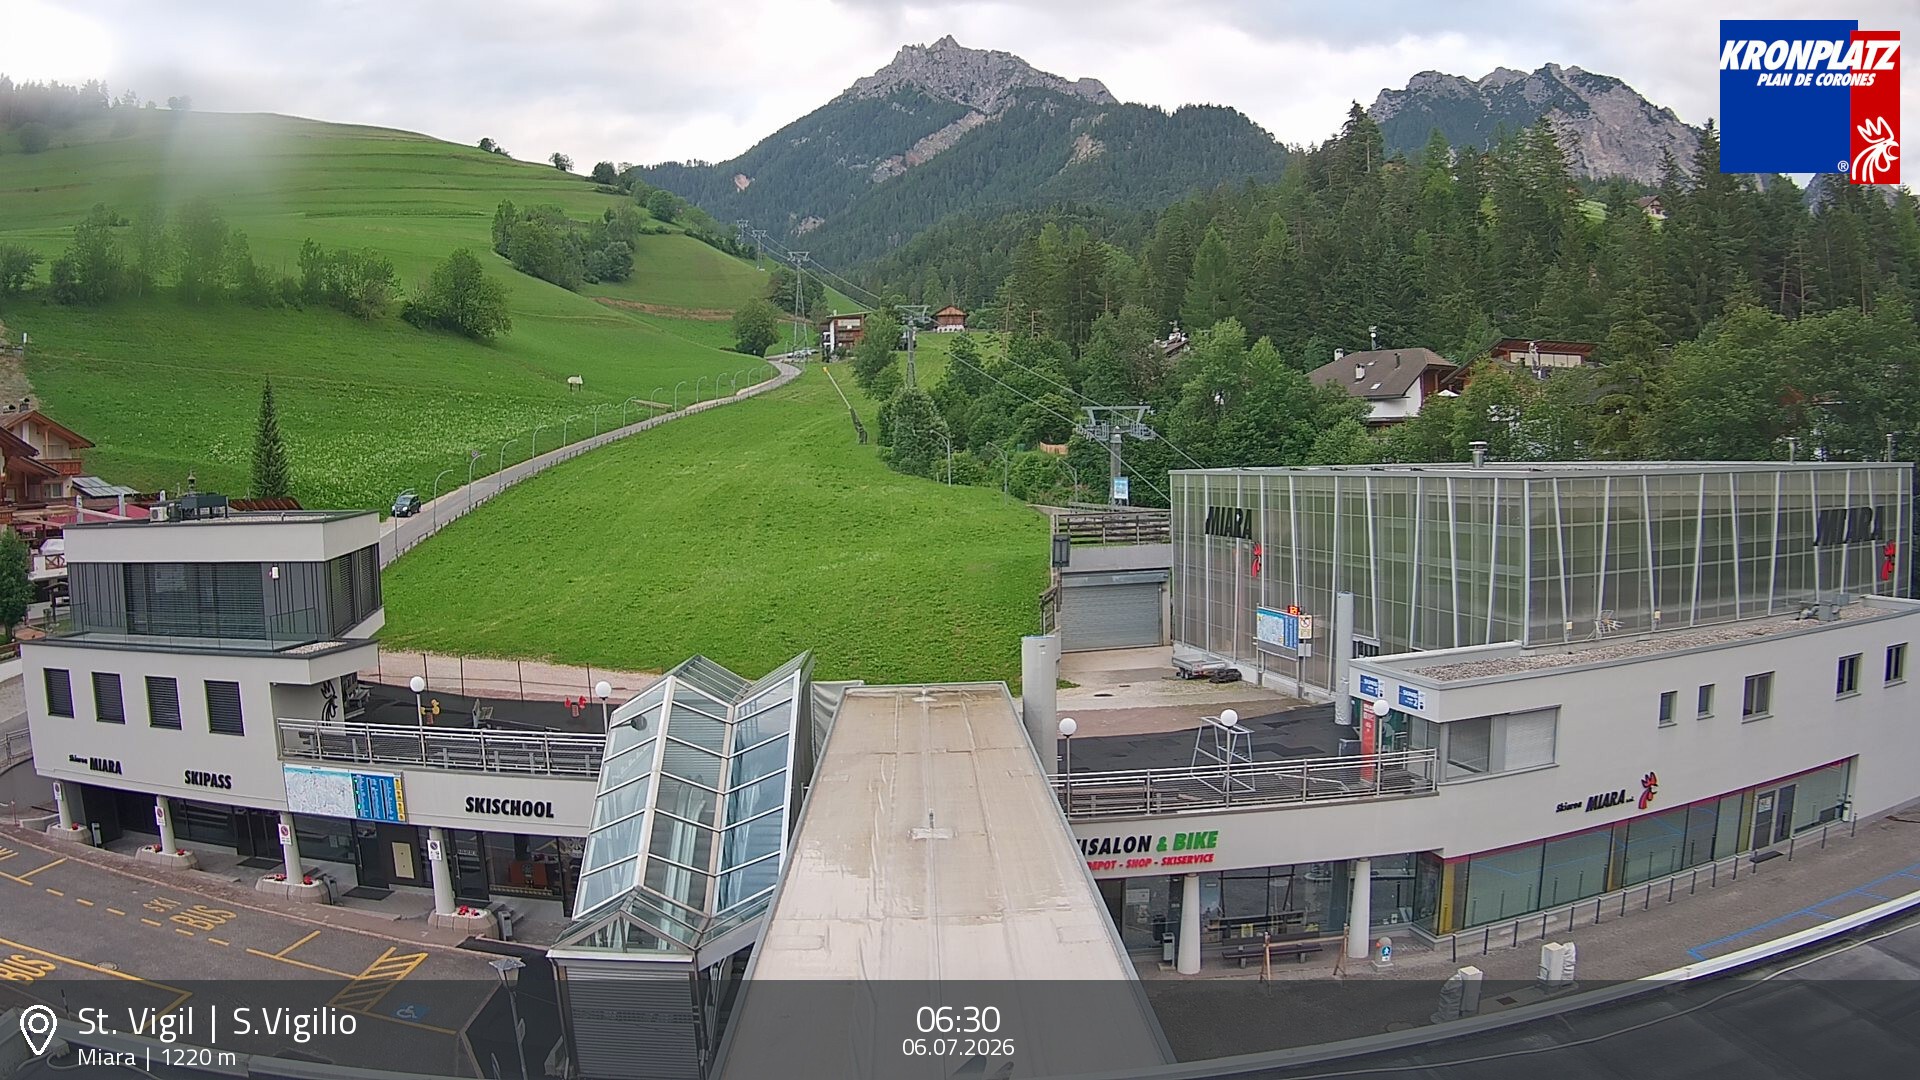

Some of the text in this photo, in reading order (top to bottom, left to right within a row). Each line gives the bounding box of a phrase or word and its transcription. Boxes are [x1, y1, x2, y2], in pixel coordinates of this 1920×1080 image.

[1205, 506, 1252, 540] MIARA
[1813, 506, 1884, 546] MIARA
[89, 757, 122, 775] MIARA
[184, 770, 232, 789] SKIPASS
[465, 796, 554, 818] SKISCHOOL
[1585, 789, 1626, 812] MIARA
[1156, 836, 1168, 852] &
[1172, 830, 1219, 851] BIKE
[1126, 858, 1152, 869] SHOP
[1161, 853, 1214, 866] SKISERVICE
[143, 896, 181, 912] SKI
[169, 904, 237, 931] BUS
